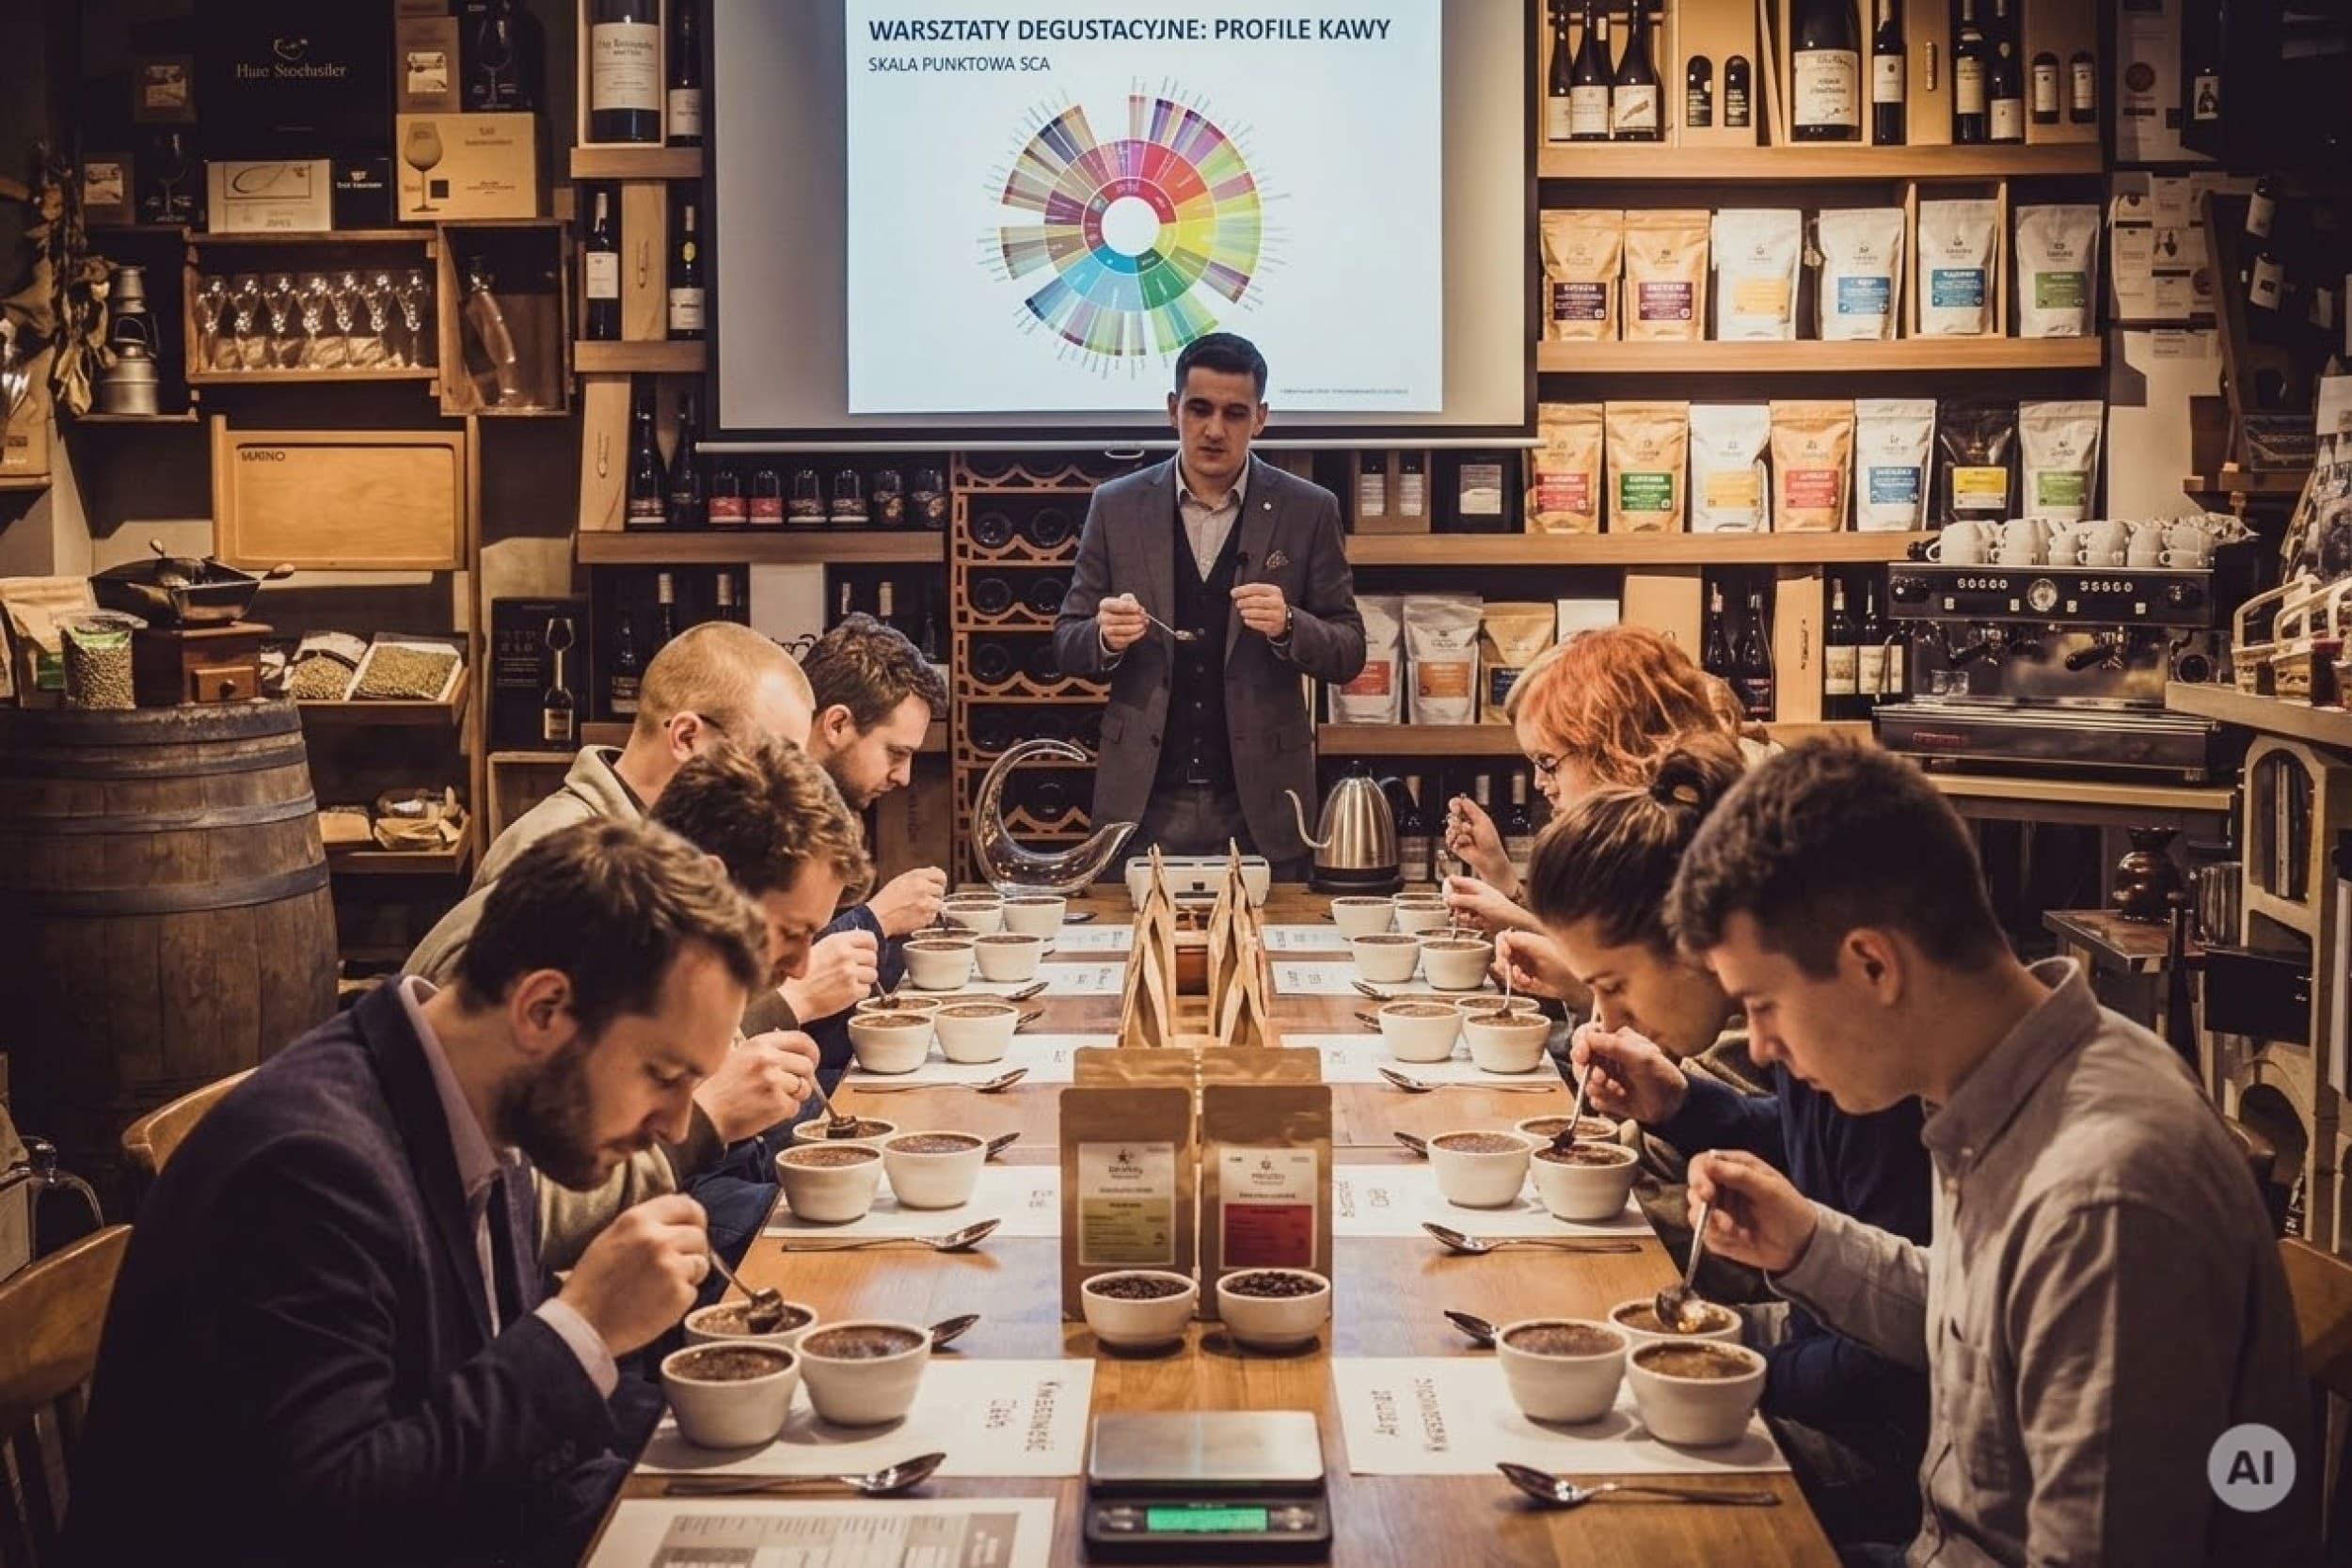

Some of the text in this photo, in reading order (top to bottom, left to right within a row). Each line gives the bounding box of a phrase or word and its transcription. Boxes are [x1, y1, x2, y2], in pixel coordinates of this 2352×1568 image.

[869, 19, 1391, 40] WARSZTATY DEGUSTACYJNE: PROFILE KAWY
[868, 56, 1051, 71] SKALA PUNKTOWA SCA
